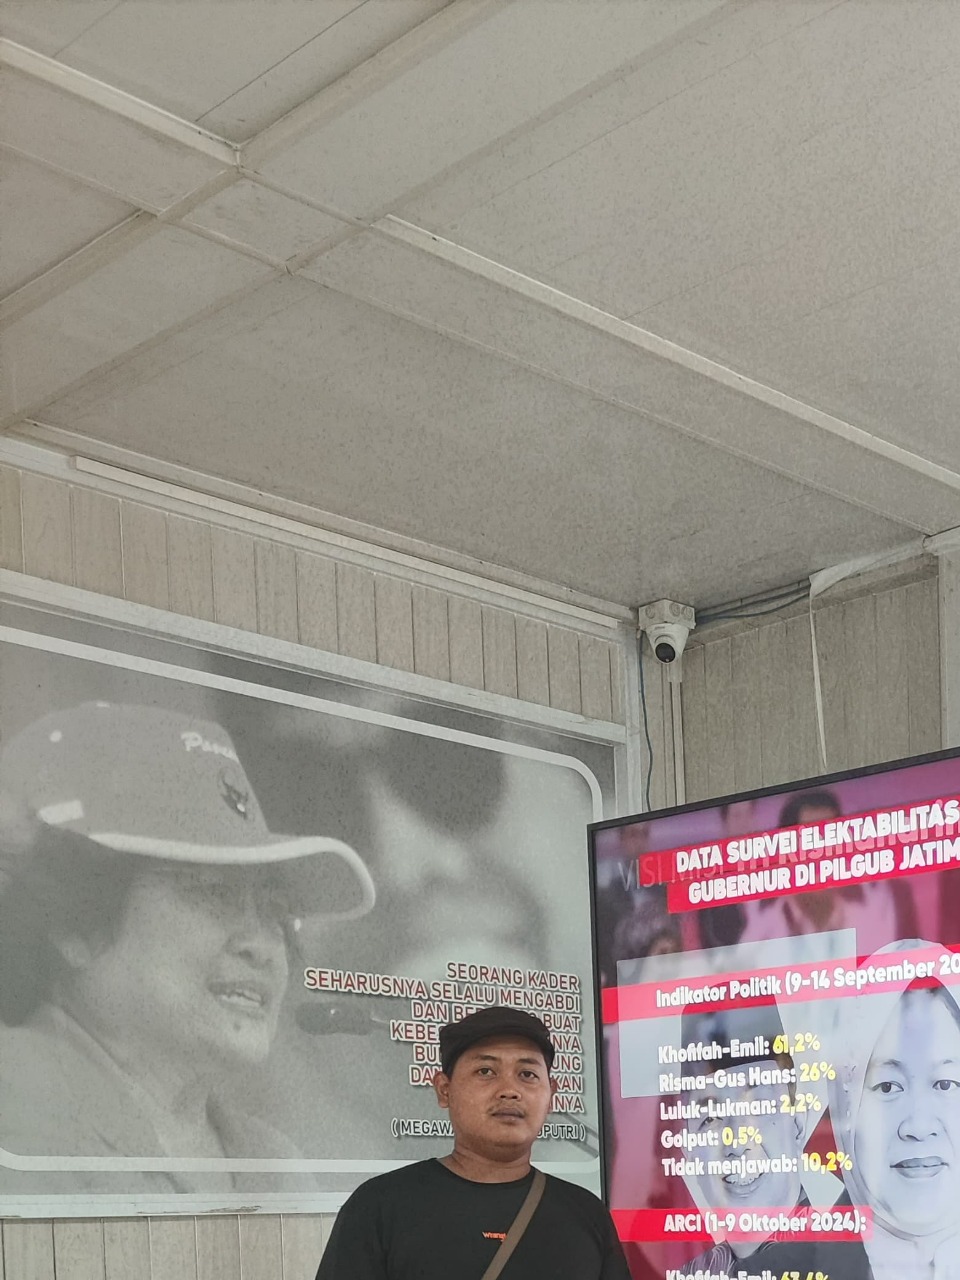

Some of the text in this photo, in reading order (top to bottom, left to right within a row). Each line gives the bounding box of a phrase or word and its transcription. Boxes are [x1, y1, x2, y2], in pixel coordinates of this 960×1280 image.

[676, 844, 723, 873] DATA
[726, 830, 797, 864] SURVEI
[800, 799, 959, 851] ELEKTABILITAS
[688, 867, 791, 904] GUBERNUR
[794, 862, 816, 887] DI
[819, 849, 894, 883] PILGUB
[304, 967, 581, 1013] SEHARUSNYA SELALU MENGABDI
[447, 962, 580, 992] SEORANG KADER
[656, 985, 727, 1008] Indikator
[729, 975, 781, 1000] Politik
[785, 969, 831, 996] (9-14
[833, 959, 936, 990] September
[411, 1001, 448, 1022] DAN
[656, 1030, 821, 1065] Khofifah-Emil: 61,2%
[658, 1061, 836, 1092] Risma-Gus Hans: 26%
[660, 1092, 822, 1120] Luluk-Lukman: 2,2%
[660, 1125, 763, 1152] Golput: 0,5%
[661, 1150, 853, 1179] Tidak menjawab: 10,2%
[664, 1210, 867, 1234] ARCI (1-9 Oktober 2024):
